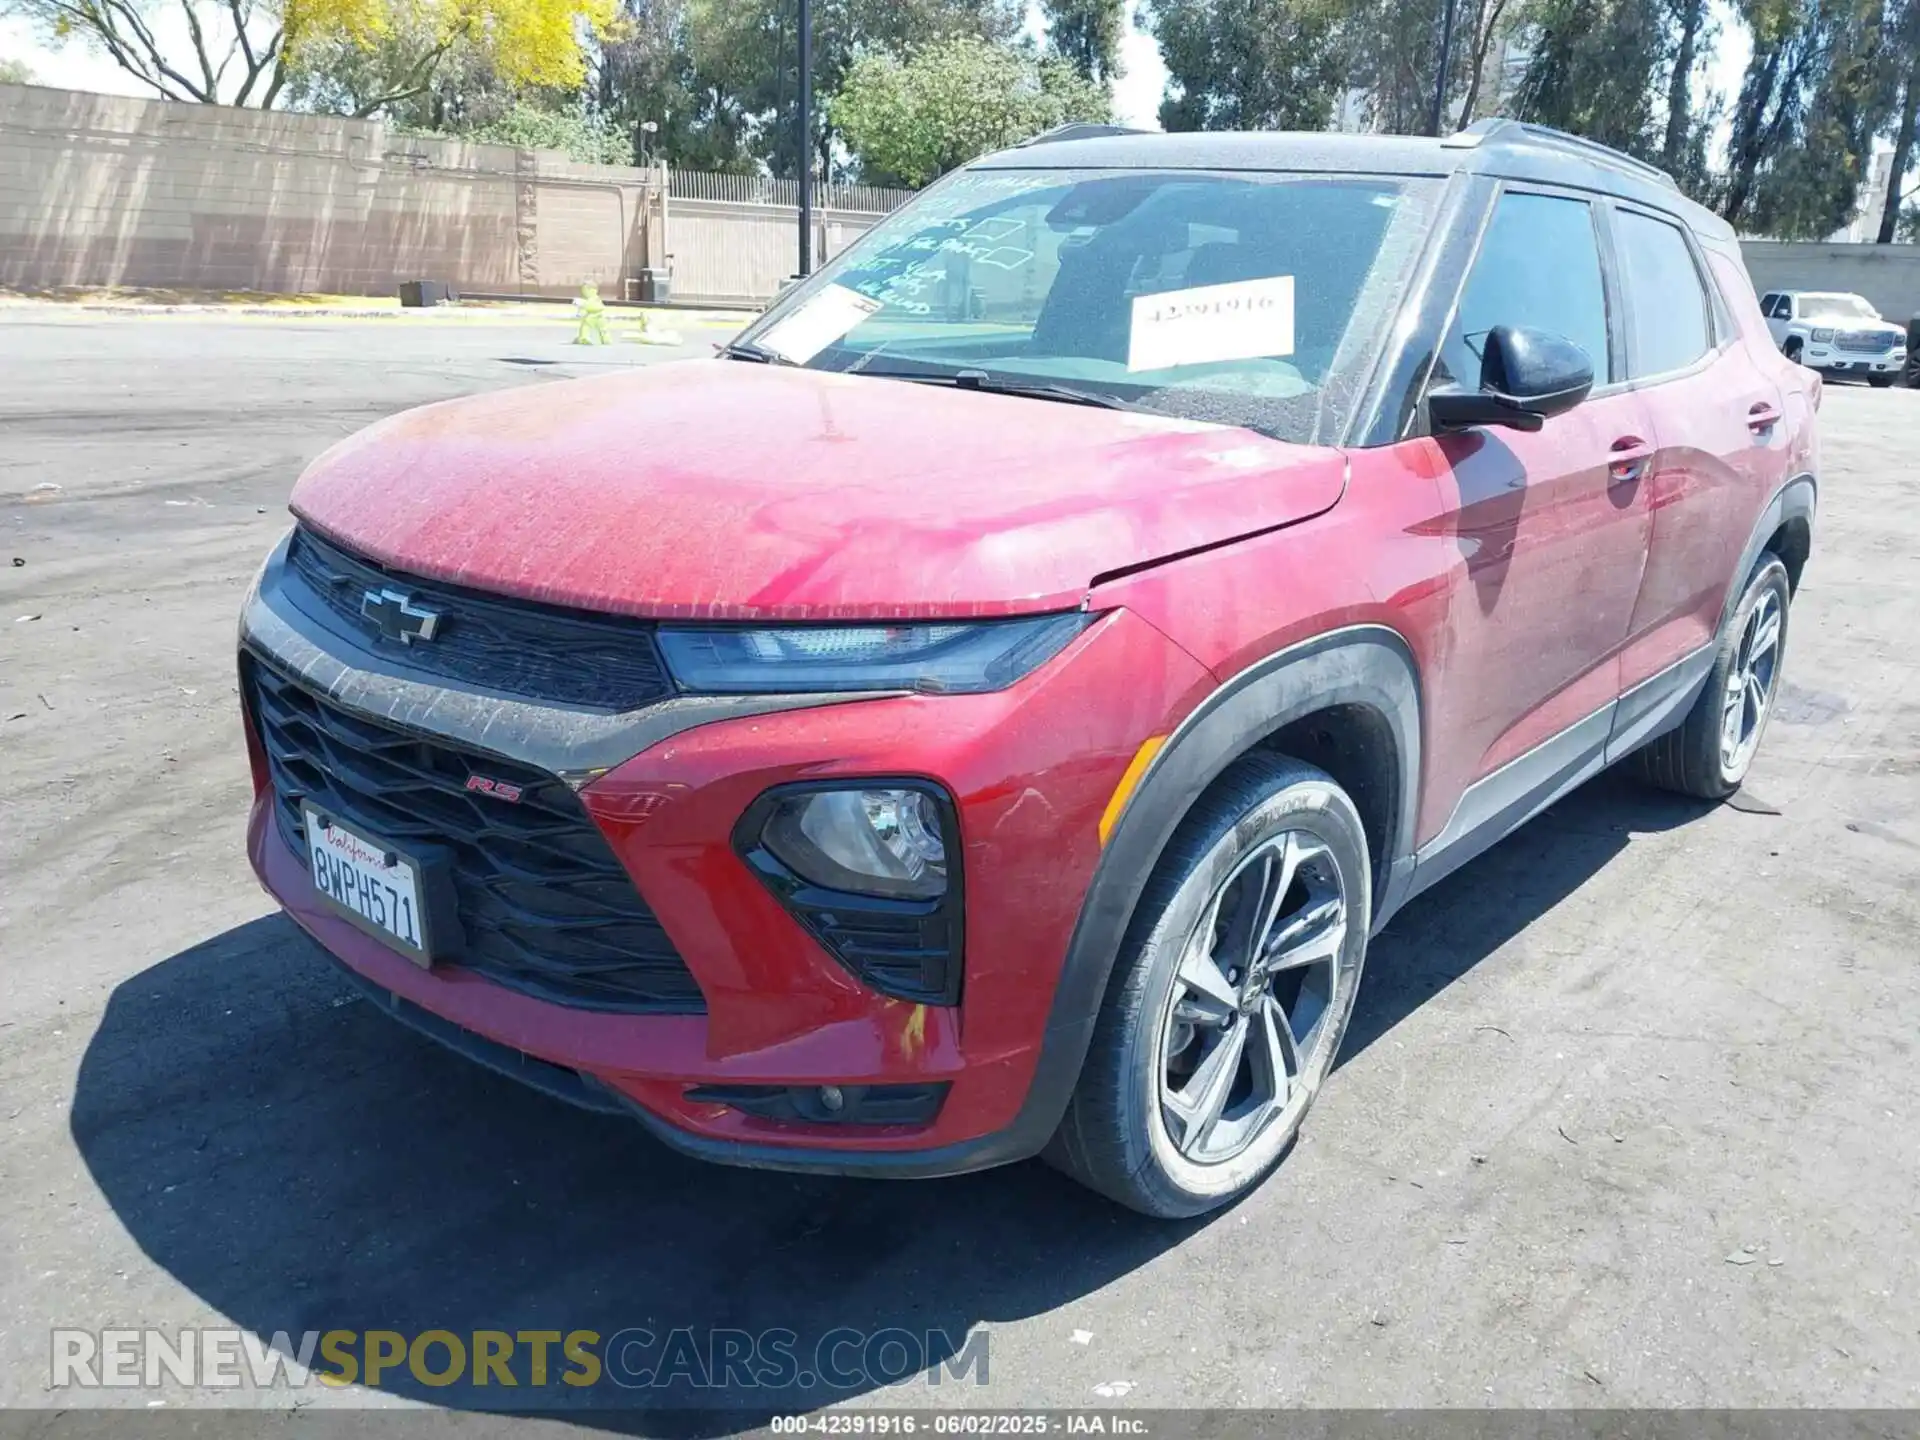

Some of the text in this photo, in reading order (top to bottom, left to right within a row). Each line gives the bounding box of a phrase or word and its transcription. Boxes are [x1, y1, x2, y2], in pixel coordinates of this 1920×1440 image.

[465, 775, 522, 802] RS
[323, 823, 392, 871] Californi
[314, 846, 420, 948] 8WPH571
